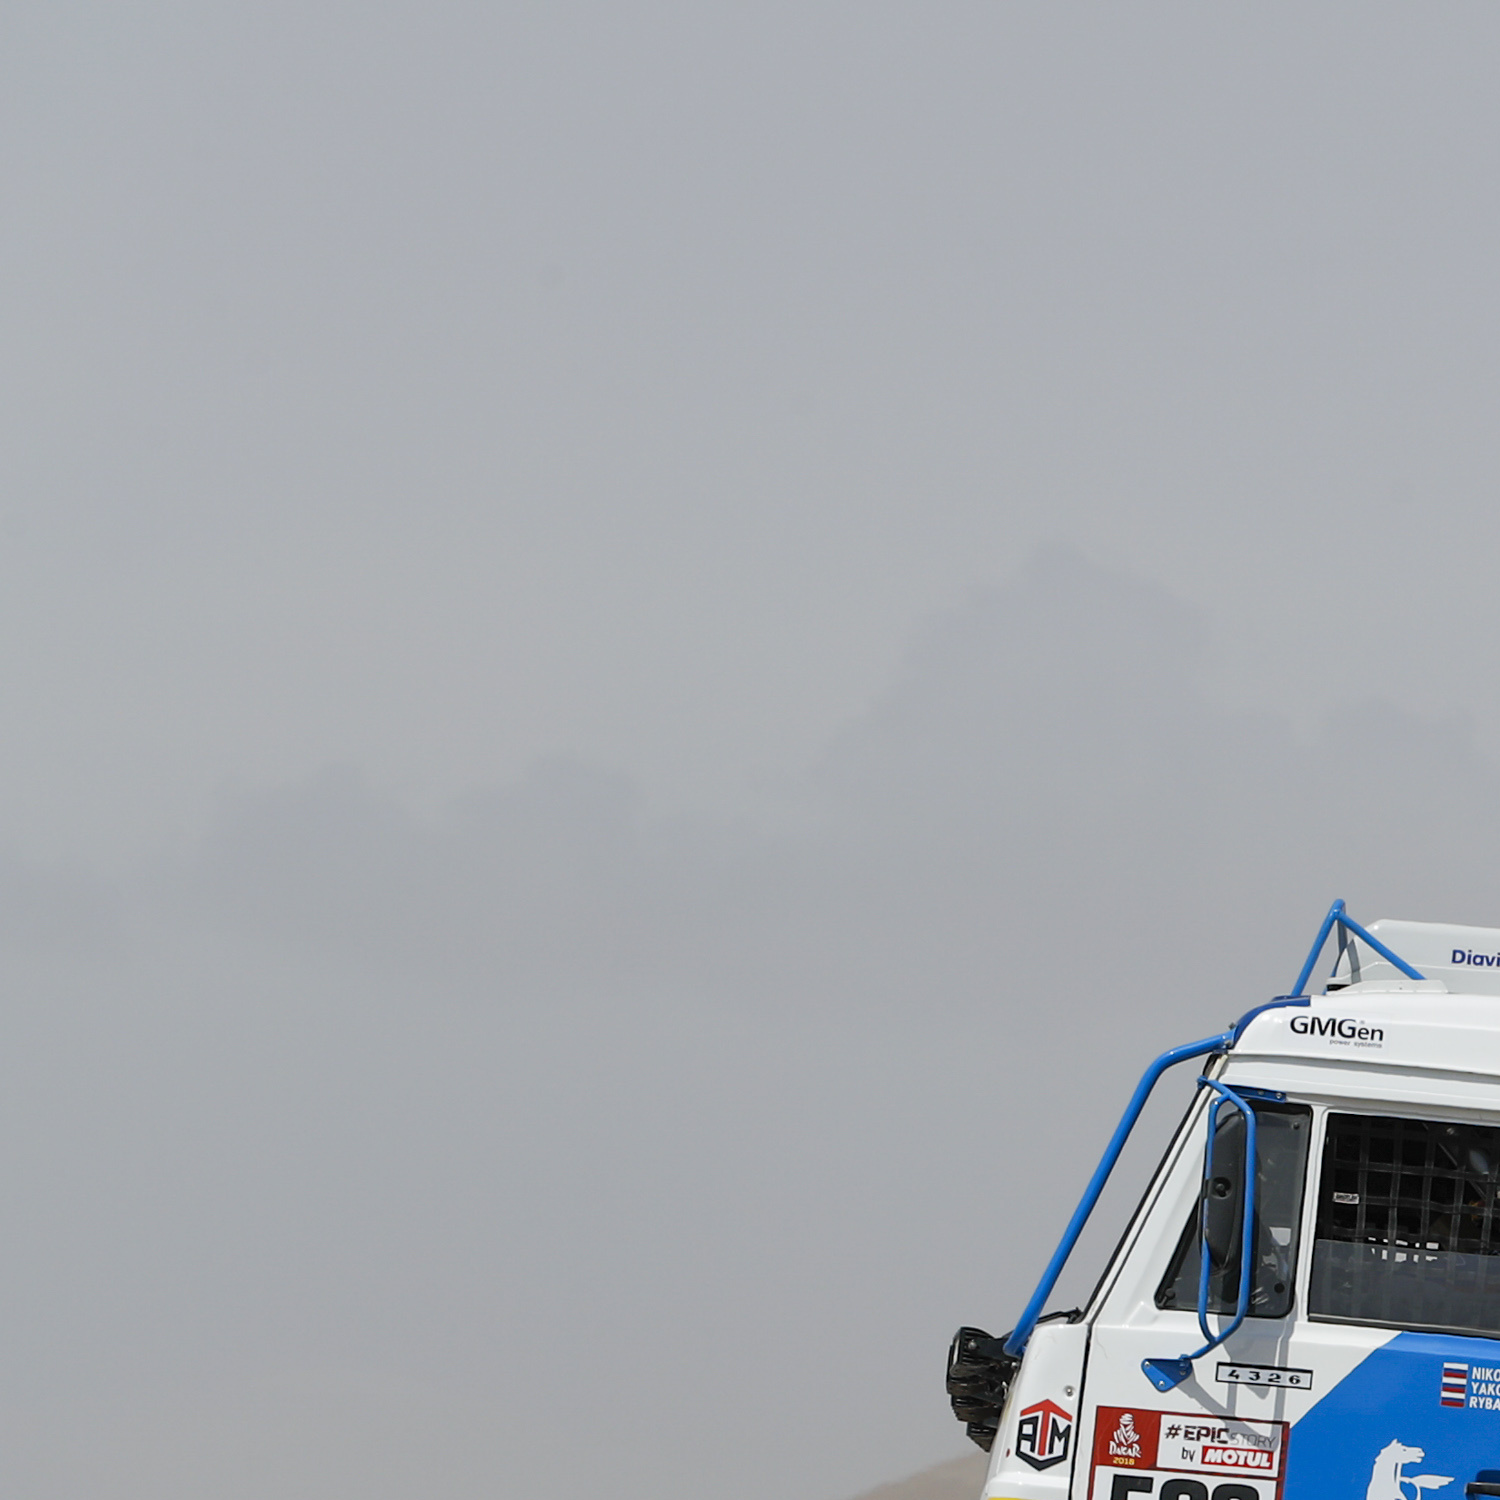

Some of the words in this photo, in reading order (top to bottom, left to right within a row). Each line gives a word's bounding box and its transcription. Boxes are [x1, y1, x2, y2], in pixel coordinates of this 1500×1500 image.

[1290, 1015, 1384, 1041] GMGen
[1112, 1456, 1135, 1466] 2018
[1181, 1447, 1195, 1462] by
[1203, 1448, 1271, 1467] MOTUL
